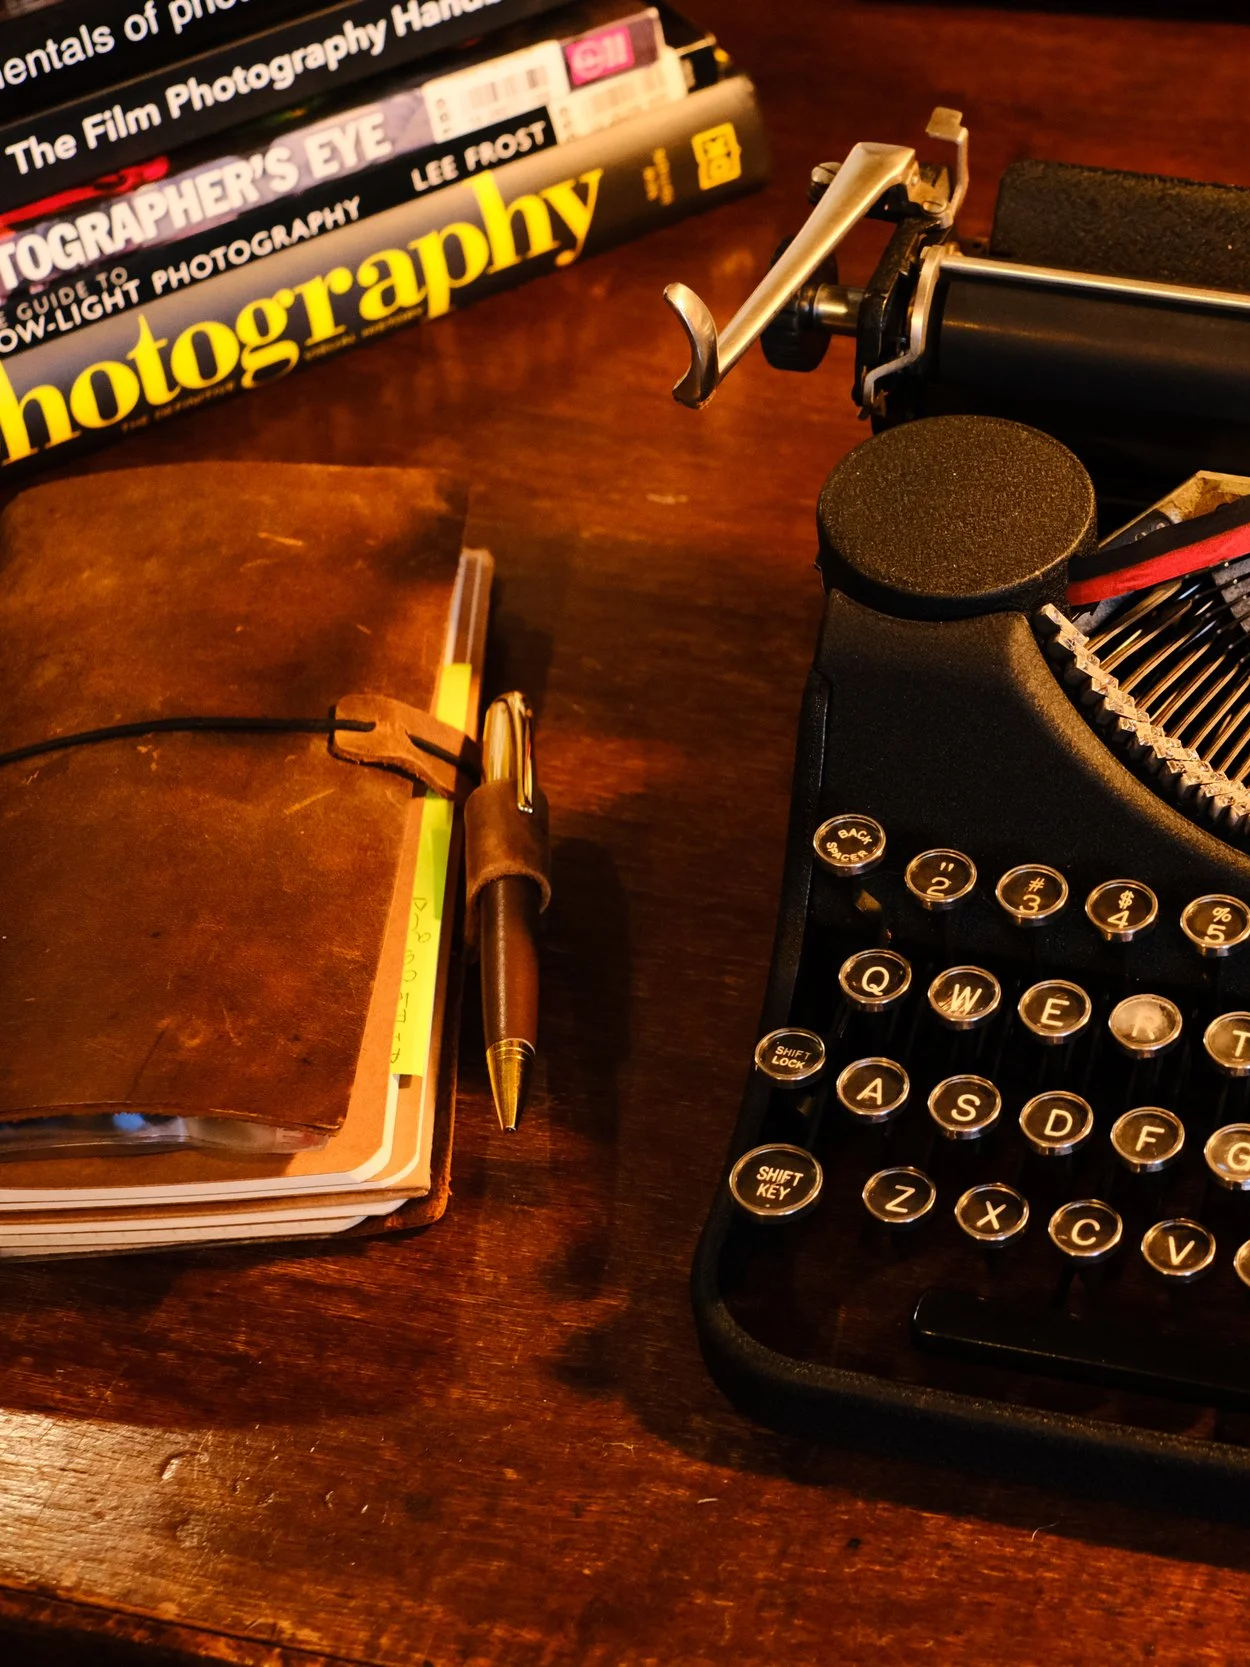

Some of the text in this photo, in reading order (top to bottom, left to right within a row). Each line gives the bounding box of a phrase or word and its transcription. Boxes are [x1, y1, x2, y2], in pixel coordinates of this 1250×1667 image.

[0, 24, 115, 90] entals
[124, 0, 159, 42] of
[5, 135, 77, 175] The
[82, 104, 162, 150] Film
[165, 18, 388, 120] Photography
[304, 112, 393, 180] EYE
[411, 154, 458, 192] LEE
[464, 120, 547, 172] FROST
[151, 195, 361, 295] PHOTOGRAPHY
[16, 281, 89, 321] GUIDE
[96, 266, 128, 290] TO
[837, 828, 873, 845] BACK
[826, 841, 870, 863] SPACER
[927, 877, 949, 895] 2
[1018, 896, 1040, 913] 3
[1212, 906, 1232, 923] %
[1107, 910, 1128, 928] 4
[1204, 924, 1225, 943] 5
[862, 965, 890, 995] Q
[950, 984, 982, 1015] W
[1041, 999, 1070, 1026] E
[1131, 1013, 1157, 1038] R
[772, 1055, 806, 1072] LOCK
[775, 1045, 812, 1061] SHIFT
[855, 1078, 883, 1105] A
[953, 1094, 981, 1121] S
[1044, 1110, 1072, 1137] D
[1137, 1125, 1165, 1152] F
[756, 1166, 803, 1186] SHIFT
[756, 1182, 791, 1201] KEY
[885, 1185, 915, 1212] Z
[977, 1201, 1006, 1230] X
[1071, 1218, 1100, 1246] C
[1168, 1236, 1195, 1266] V
